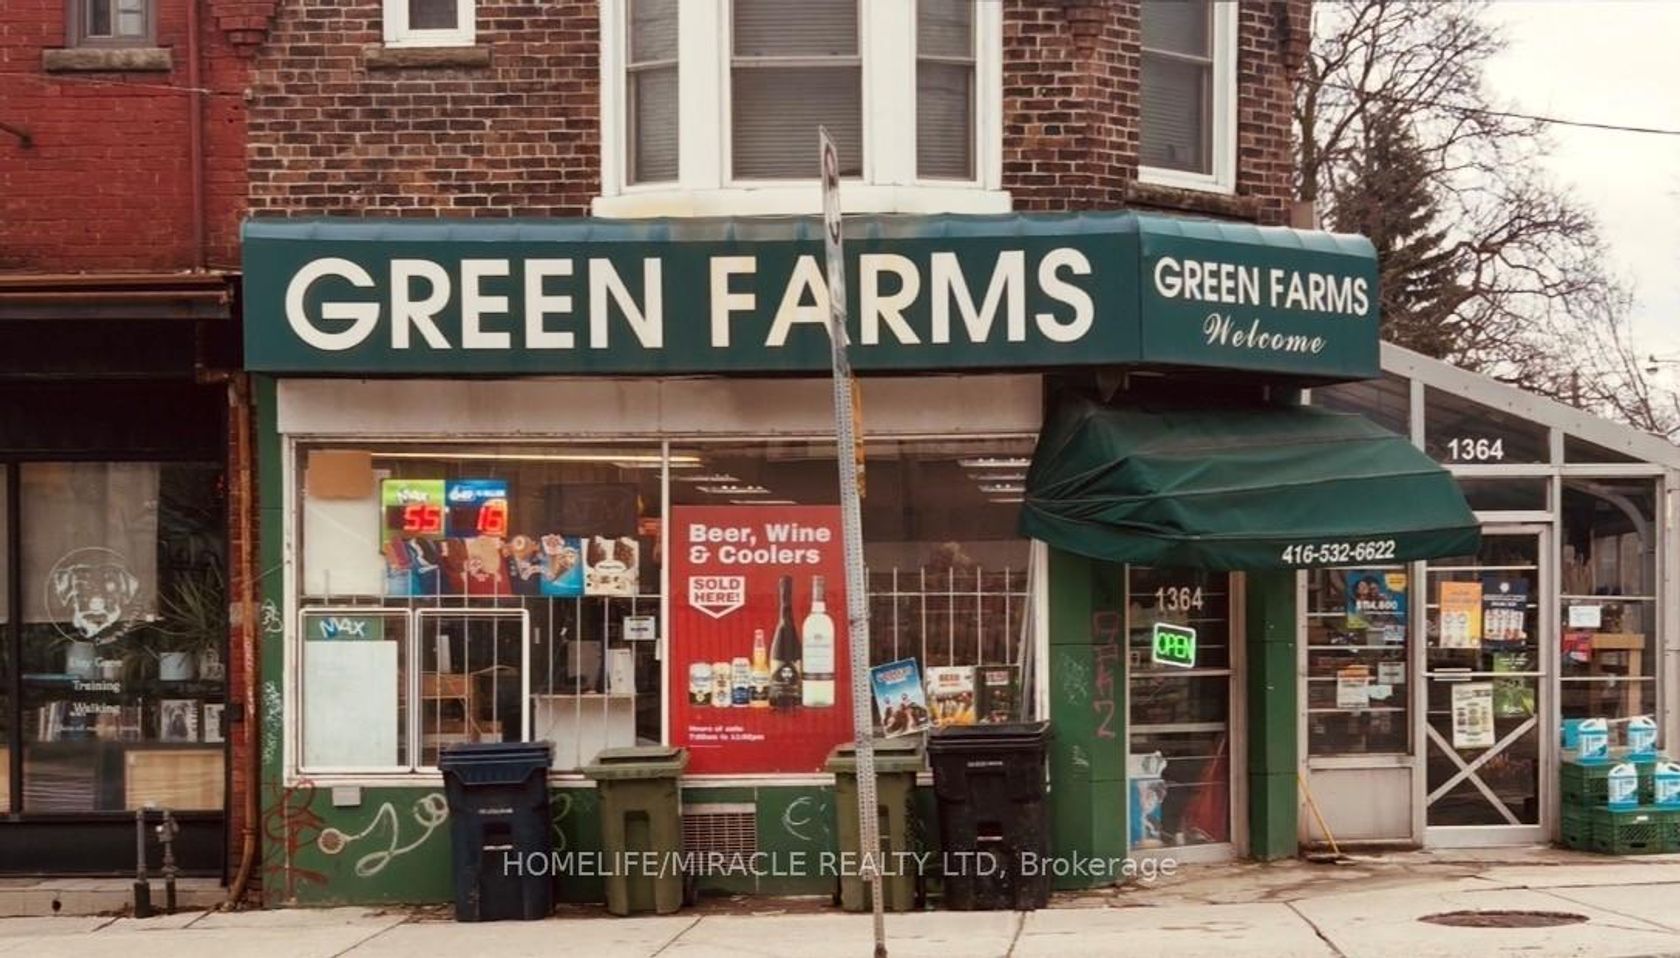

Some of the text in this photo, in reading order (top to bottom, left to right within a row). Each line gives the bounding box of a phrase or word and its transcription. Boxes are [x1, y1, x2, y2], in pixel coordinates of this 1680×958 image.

[1154, 256, 1369, 316] GREEN FARMS
[285, 247, 1095, 351] GREEN FARMS
[1203, 312, 1326, 353] Welcome
[1448, 438, 1504, 460] 1364
[403, 505, 441, 534] 55
[477, 505, 503, 534] 16
[689, 523, 831, 547] Beer, Wine
[689, 545, 821, 564] & Coolers
[1281, 540, 1396, 564] 416-532-6622
[693, 579, 741, 590] SOLD
[693, 592, 740, 603] HERE!
[1155, 586, 1204, 611] 1364
[1157, 632, 1194, 660] OPEN
[72, 680, 121, 693] Training
[73, 702, 121, 715] Walking
